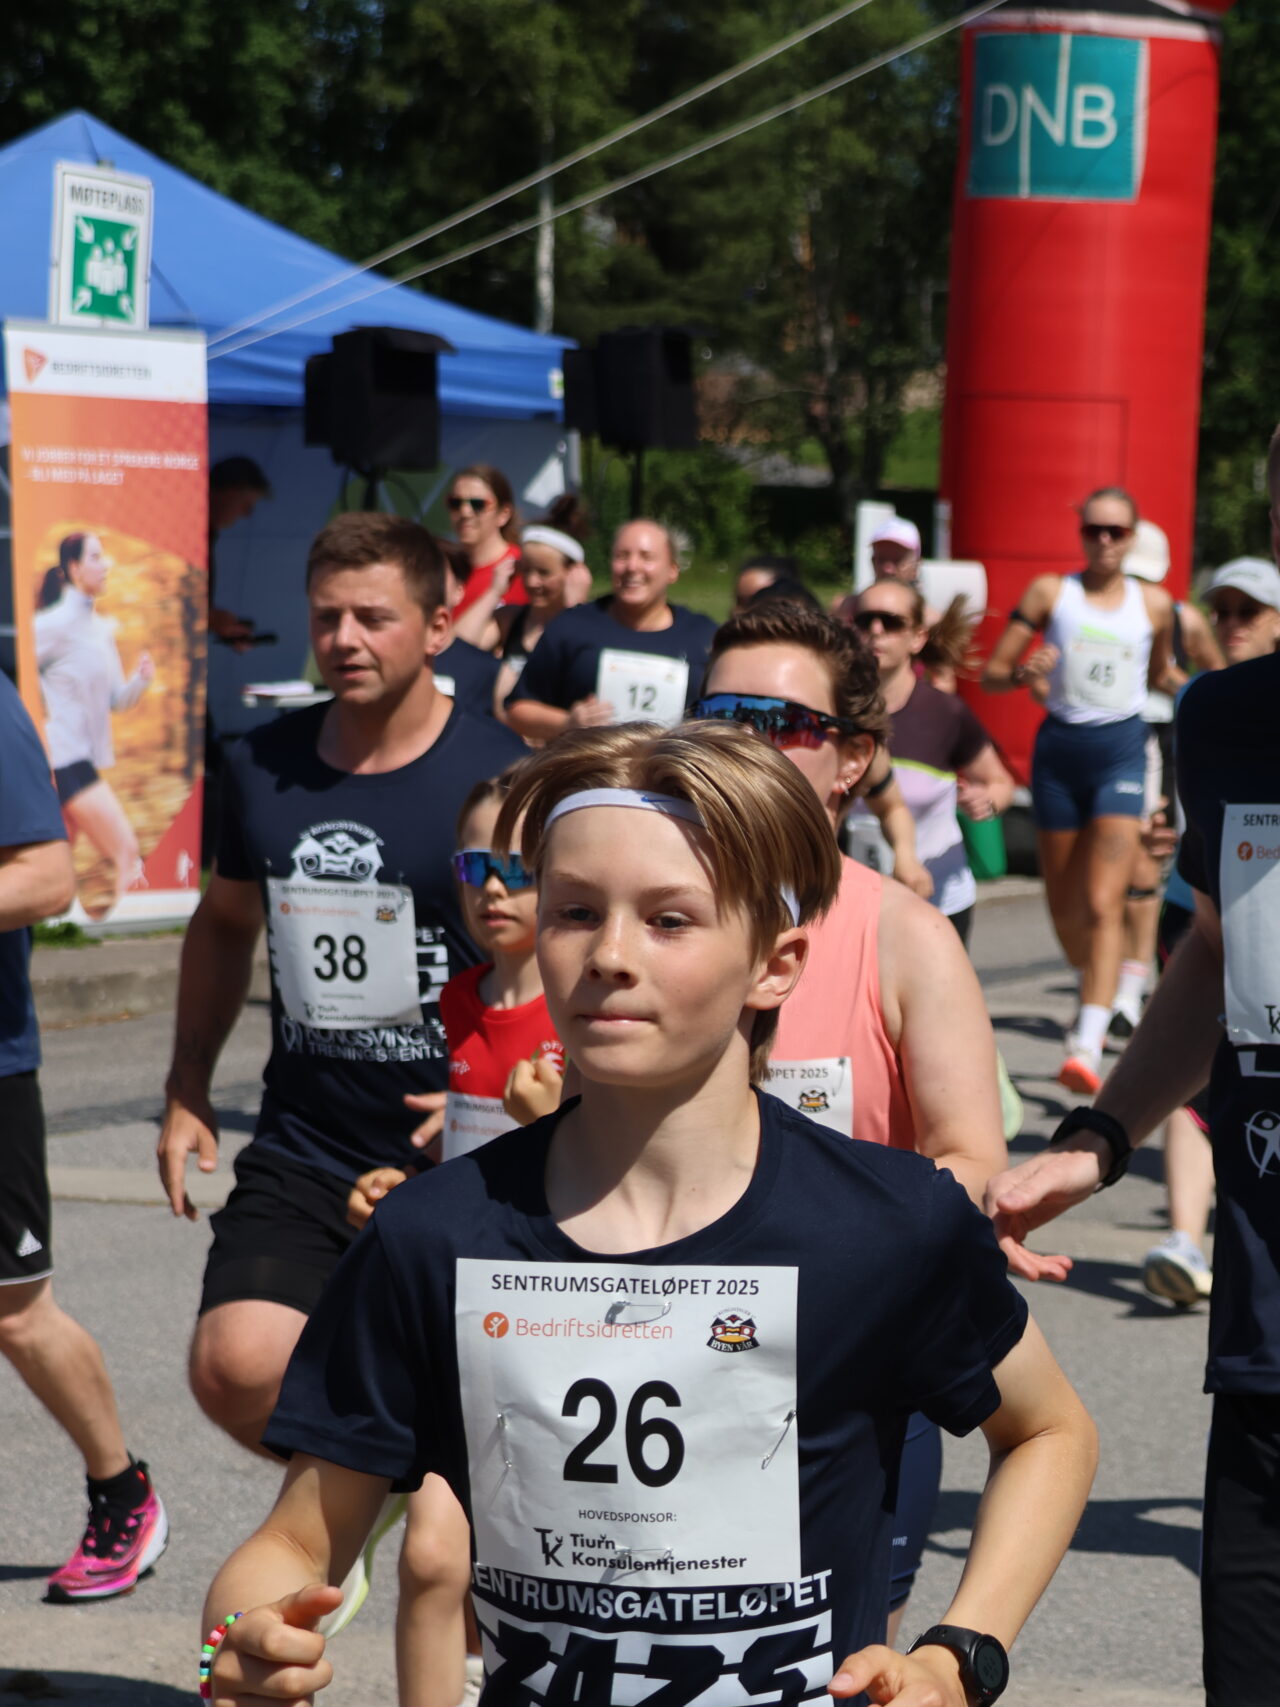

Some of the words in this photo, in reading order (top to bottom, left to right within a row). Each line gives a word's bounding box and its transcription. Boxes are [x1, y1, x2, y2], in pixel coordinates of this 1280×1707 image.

[628, 684, 658, 712] 12
[313, 934, 369, 982] 38
[800, 1067, 829, 1079] 2025
[491, 1273, 711, 1297] SENTRUMSGATELØPET
[715, 1278, 760, 1296] 2025
[515, 1317, 673, 1340] Bedriftsidretten
[710, 1339, 734, 1352] BYEN
[561, 1377, 685, 1488] 26
[578, 1509, 678, 1523] HOVEDSPONSOR:
[571, 1552, 748, 1575] Konsulenttjenester
[472, 1562, 833, 1622] ENTRUMSGATELØPET
